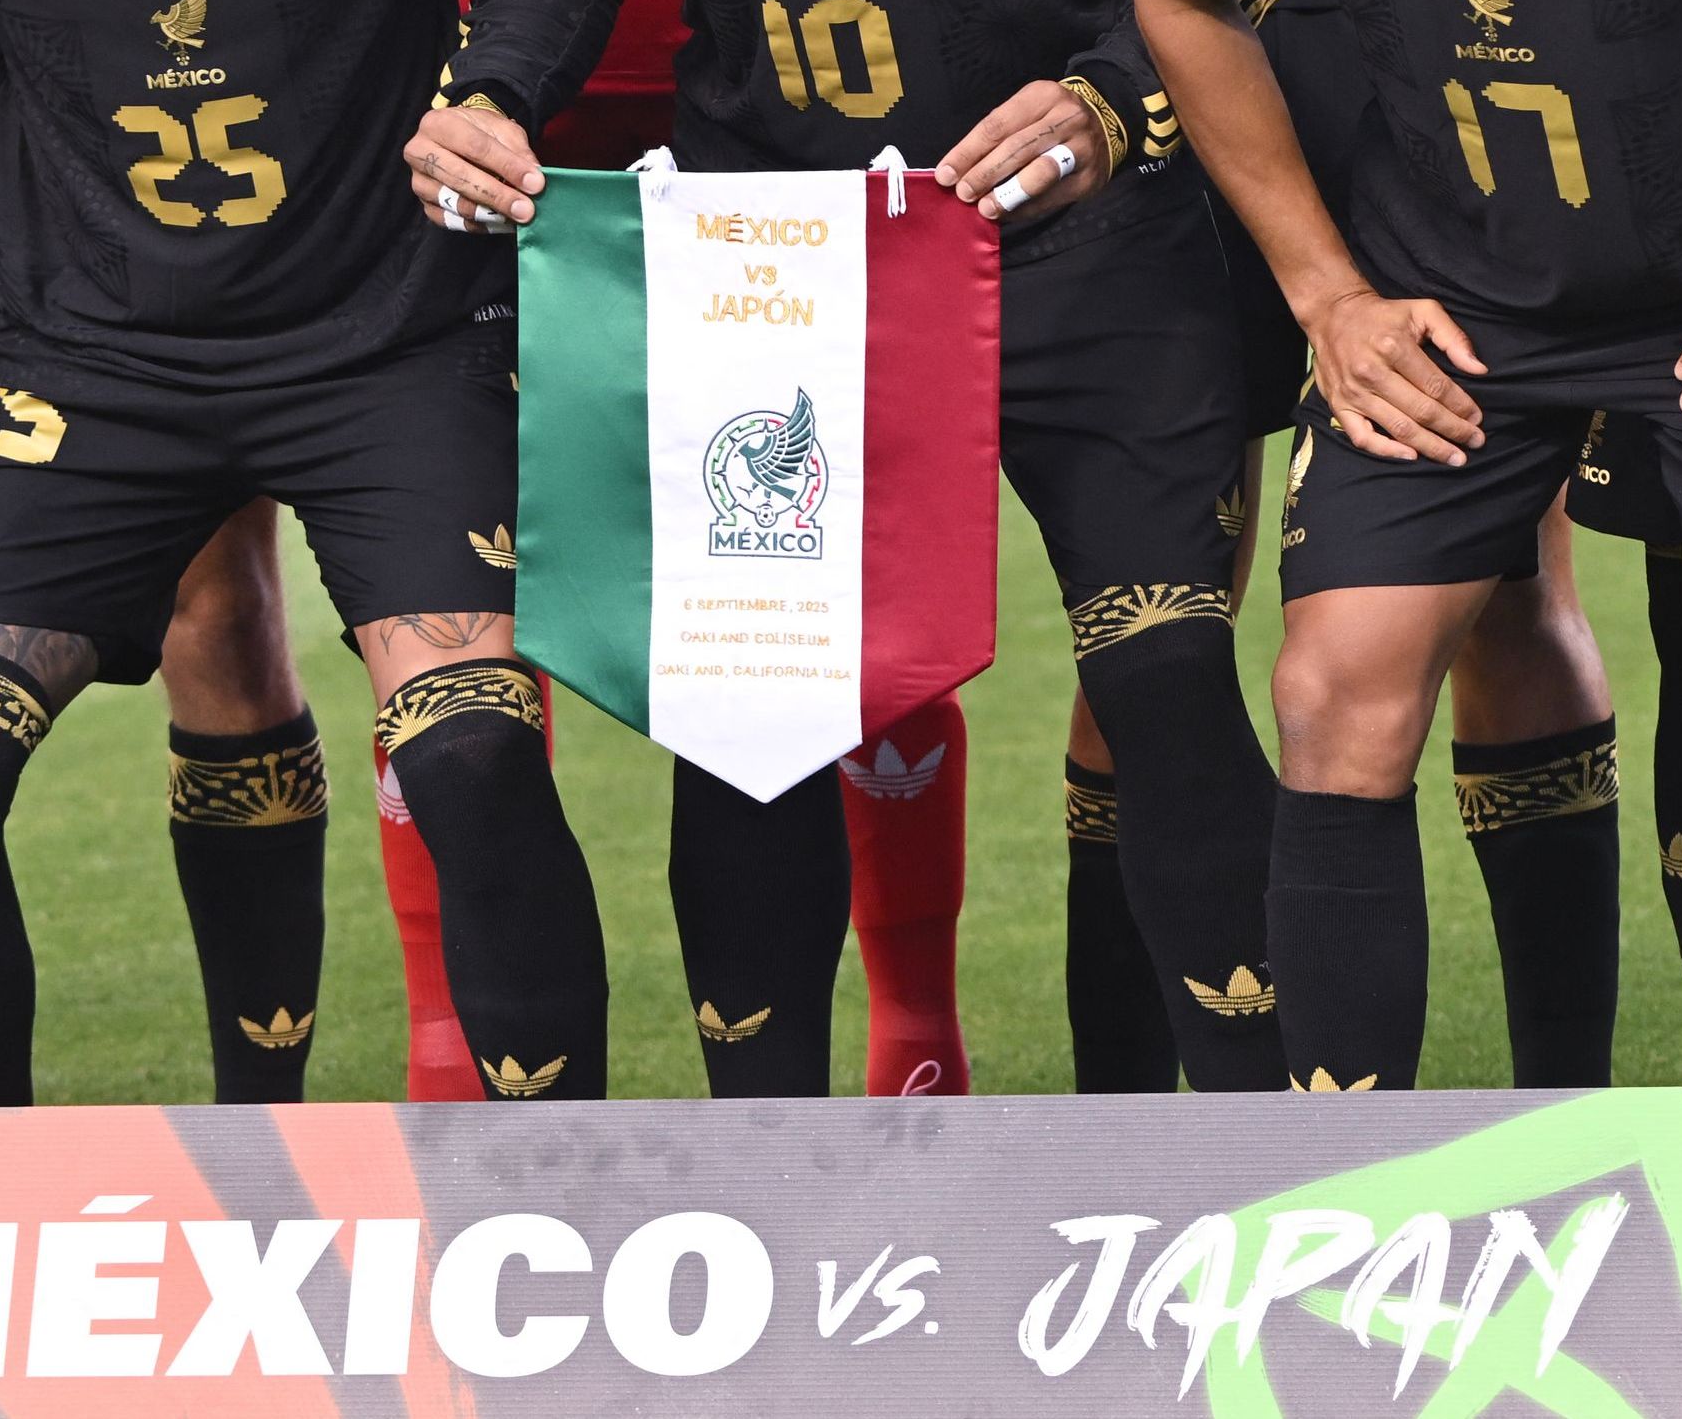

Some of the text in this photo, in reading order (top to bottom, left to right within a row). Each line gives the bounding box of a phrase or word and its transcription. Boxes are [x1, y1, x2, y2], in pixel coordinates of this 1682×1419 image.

[1454, 38, 1536, 64] MÉXICO
[145, 65, 227, 90] MÉXICO
[1442, 78, 1591, 209] 17
[111, 94, 287, 228] 25
[696, 212, 829, 247] MÉXICO
[702, 288, 815, 327] JAPÓN
[714, 525, 818, 553] MÉXICO
[683, 598, 693, 611] 6
[796, 600, 830, 614] 2025
[754, 631, 831, 647] COLISEUM
[733, 665, 819, 679] CALIFORNIA
[823, 667, 852, 681] USA
[1018, 1191, 1632, 1402] JAPAN
